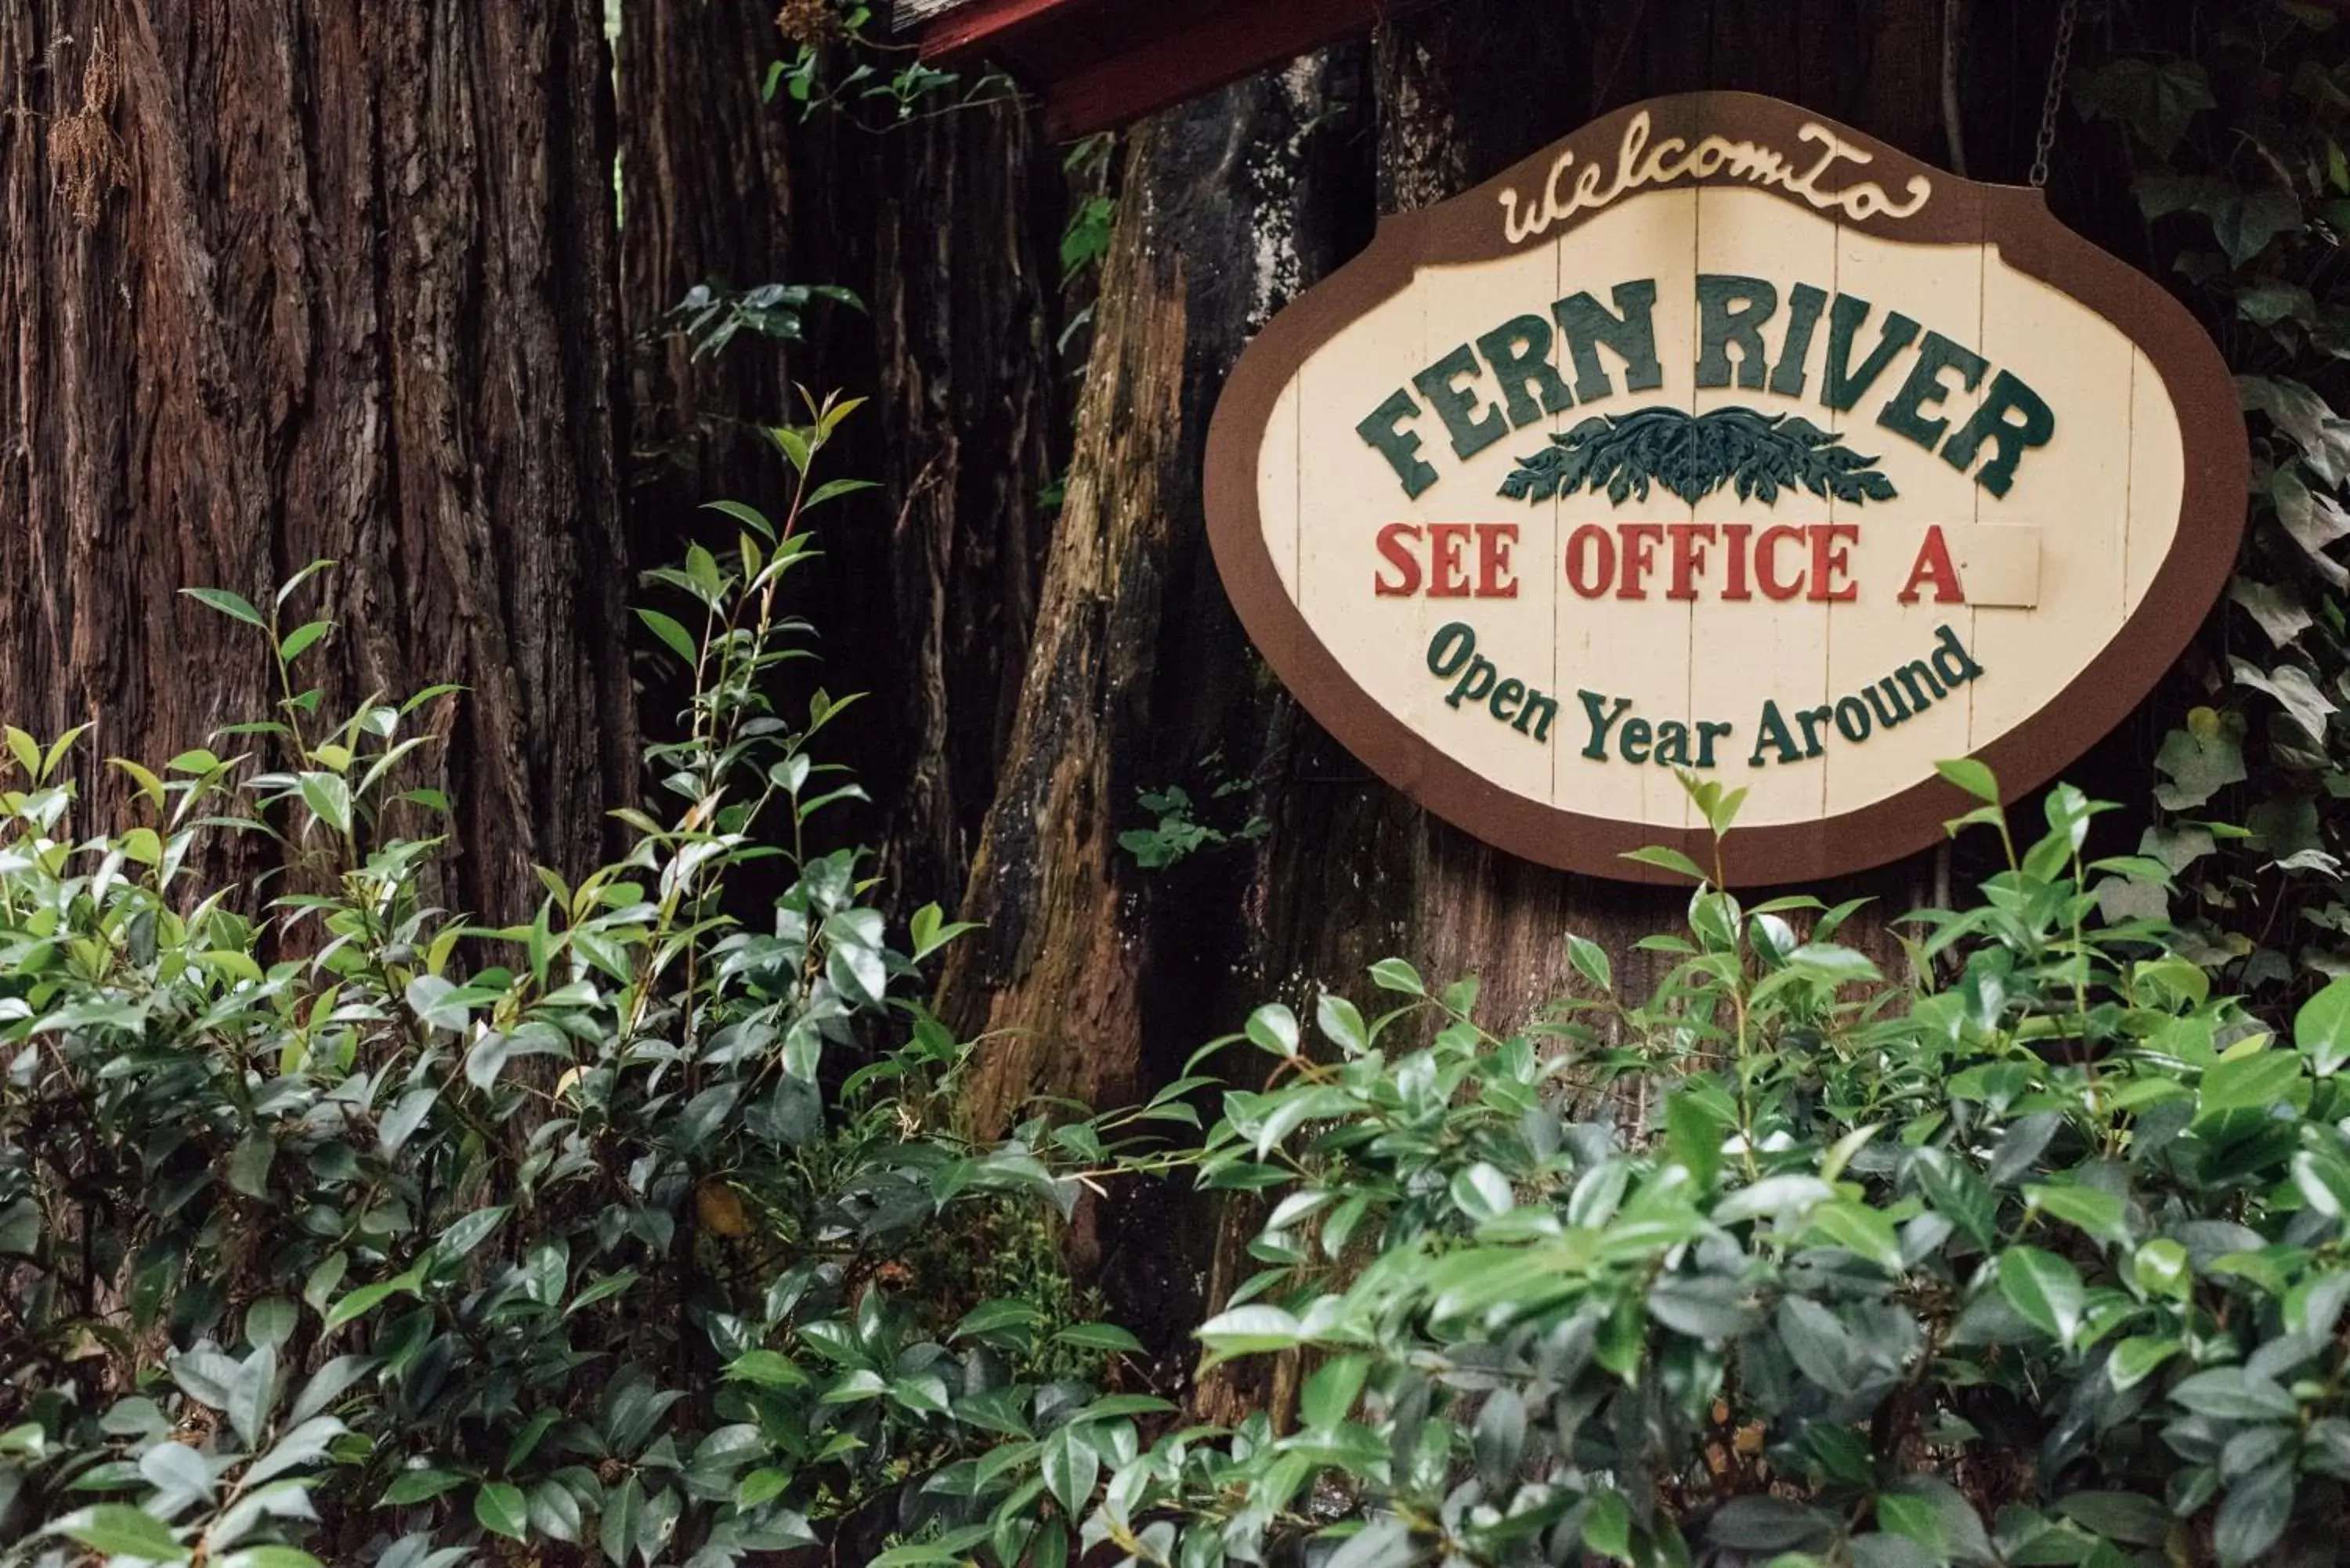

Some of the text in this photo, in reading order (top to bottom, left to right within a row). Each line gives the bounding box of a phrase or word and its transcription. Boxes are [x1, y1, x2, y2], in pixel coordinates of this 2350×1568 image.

[1799, 123, 1931, 220] To
[1356, 273, 2055, 500] FERN RIVER
[1375, 524, 1518, 598] SEE
[1566, 523, 1859, 601] OFFICE
[1426, 621, 1983, 768] Open Year Around
